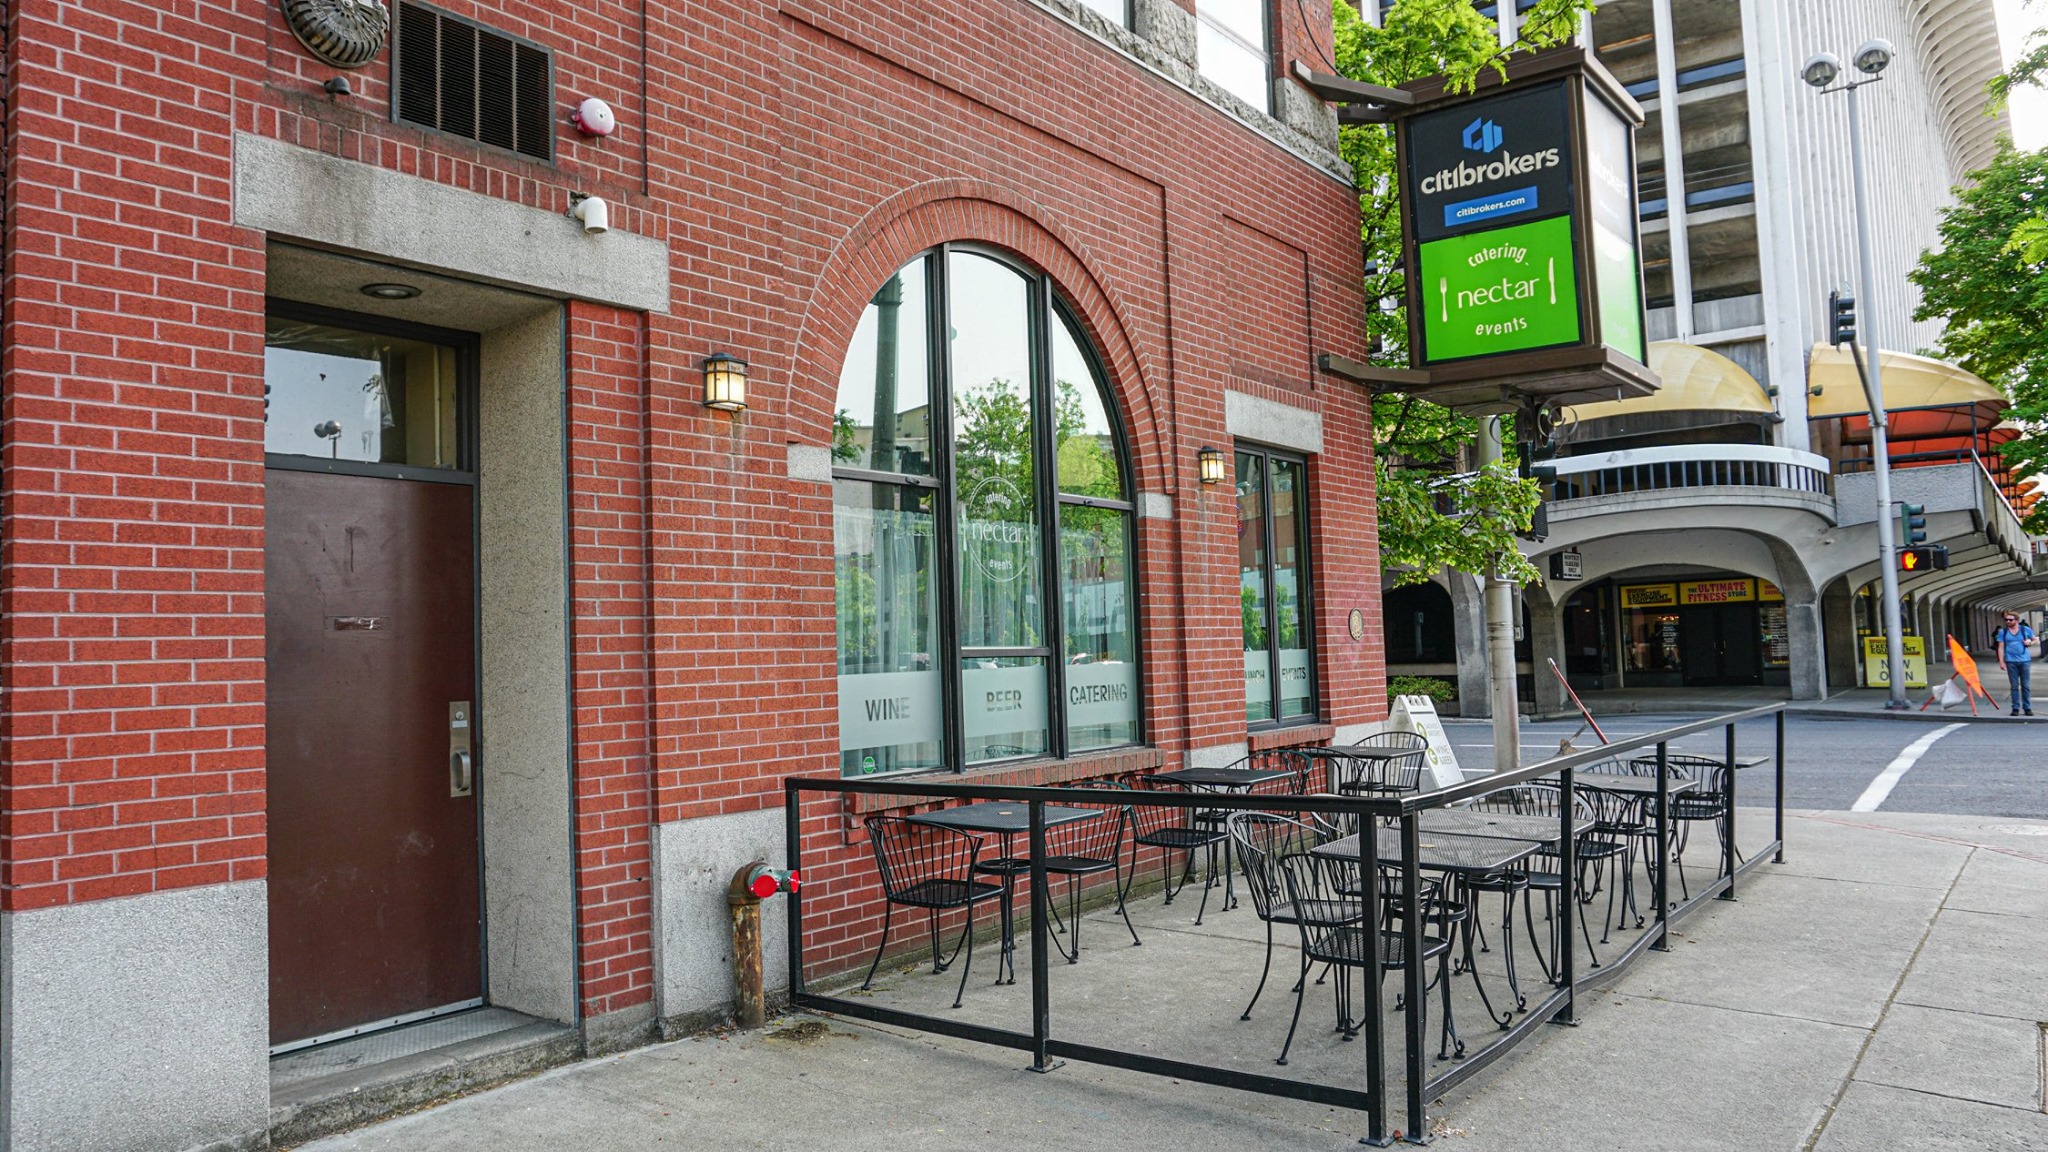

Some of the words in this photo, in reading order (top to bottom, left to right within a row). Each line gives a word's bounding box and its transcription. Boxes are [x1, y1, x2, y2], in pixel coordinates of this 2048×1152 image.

[1420, 147, 1560, 195] citibrokers
[1456, 195, 1526, 218] citibrokers.com
[1468, 242, 1528, 267] catering
[1457, 277, 1540, 309] nectar
[1475, 316, 1528, 336] events
[985, 491, 1012, 510] catering
[972, 519, 1024, 543] nectar
[989, 558, 1012, 570] events
[1688, 592, 1727, 602] FITNESS
[1697, 582, 1746, 592] ULTIMATE
[1282, 667, 1307, 680] EVENTS
[1881, 659, 1911, 669] NW
[1880, 671, 1914, 681] ON
[986, 689, 1023, 713] BEER
[1070, 683, 1128, 706] CATERING
[865, 696, 911, 722] WINE
